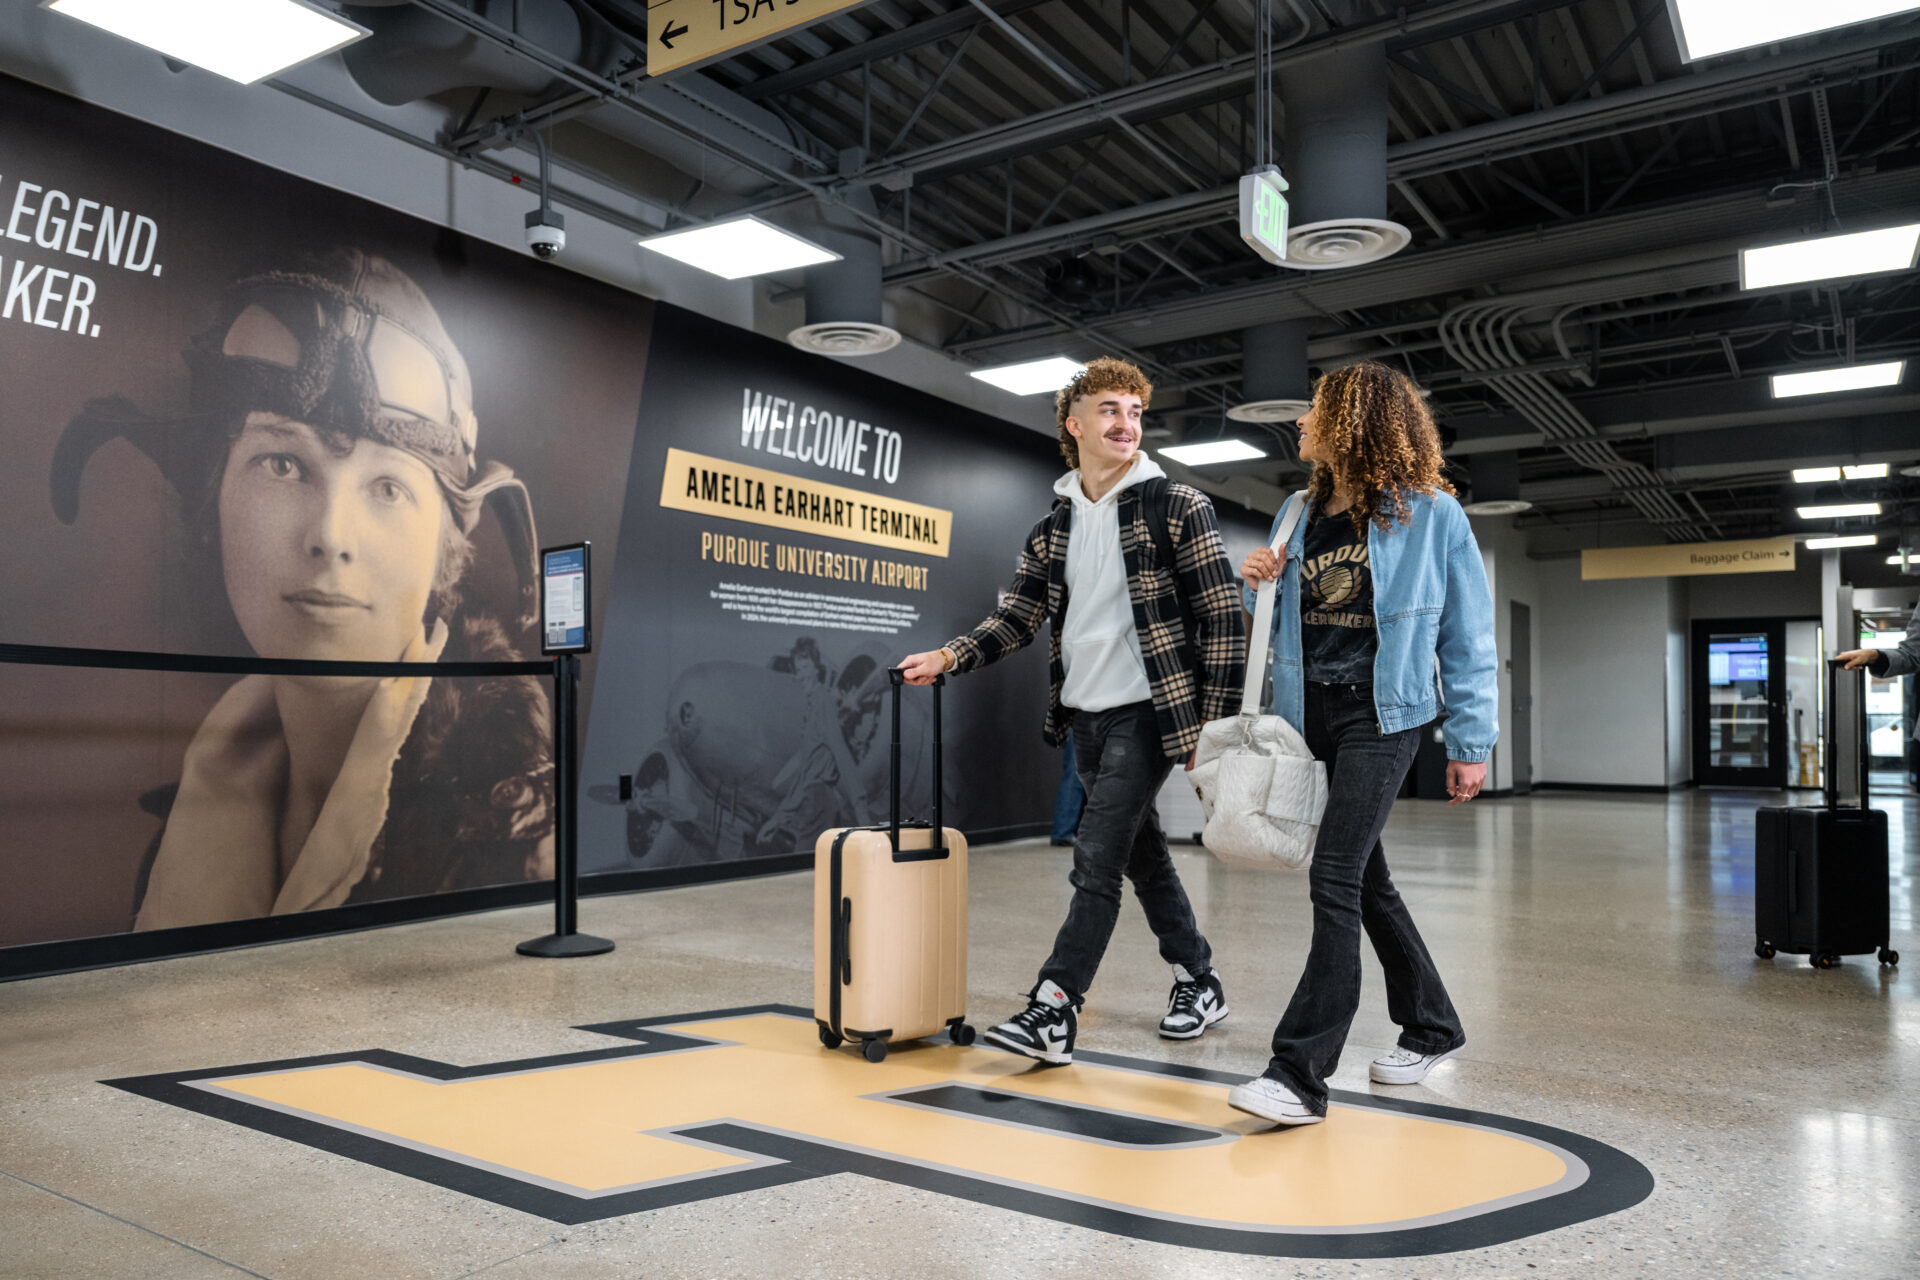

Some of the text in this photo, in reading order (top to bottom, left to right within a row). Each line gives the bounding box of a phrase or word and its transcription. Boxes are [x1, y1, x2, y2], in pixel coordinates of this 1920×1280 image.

[0, 174, 163, 277] EGEND.
[1259, 183, 1286, 252] EXIT
[0, 255, 101, 338] KER.
[740, 388, 903, 484] WELCOME TO
[686, 466, 939, 545] AMELIA EARHART TERMINAL
[701, 531, 929, 592] PURDUE UNIVERSITY AIRPORT
[1302, 544, 1370, 580] URDU
[1690, 550, 1774, 565] Baggage Claim
[1304, 612, 1377, 628] LERMAKER
